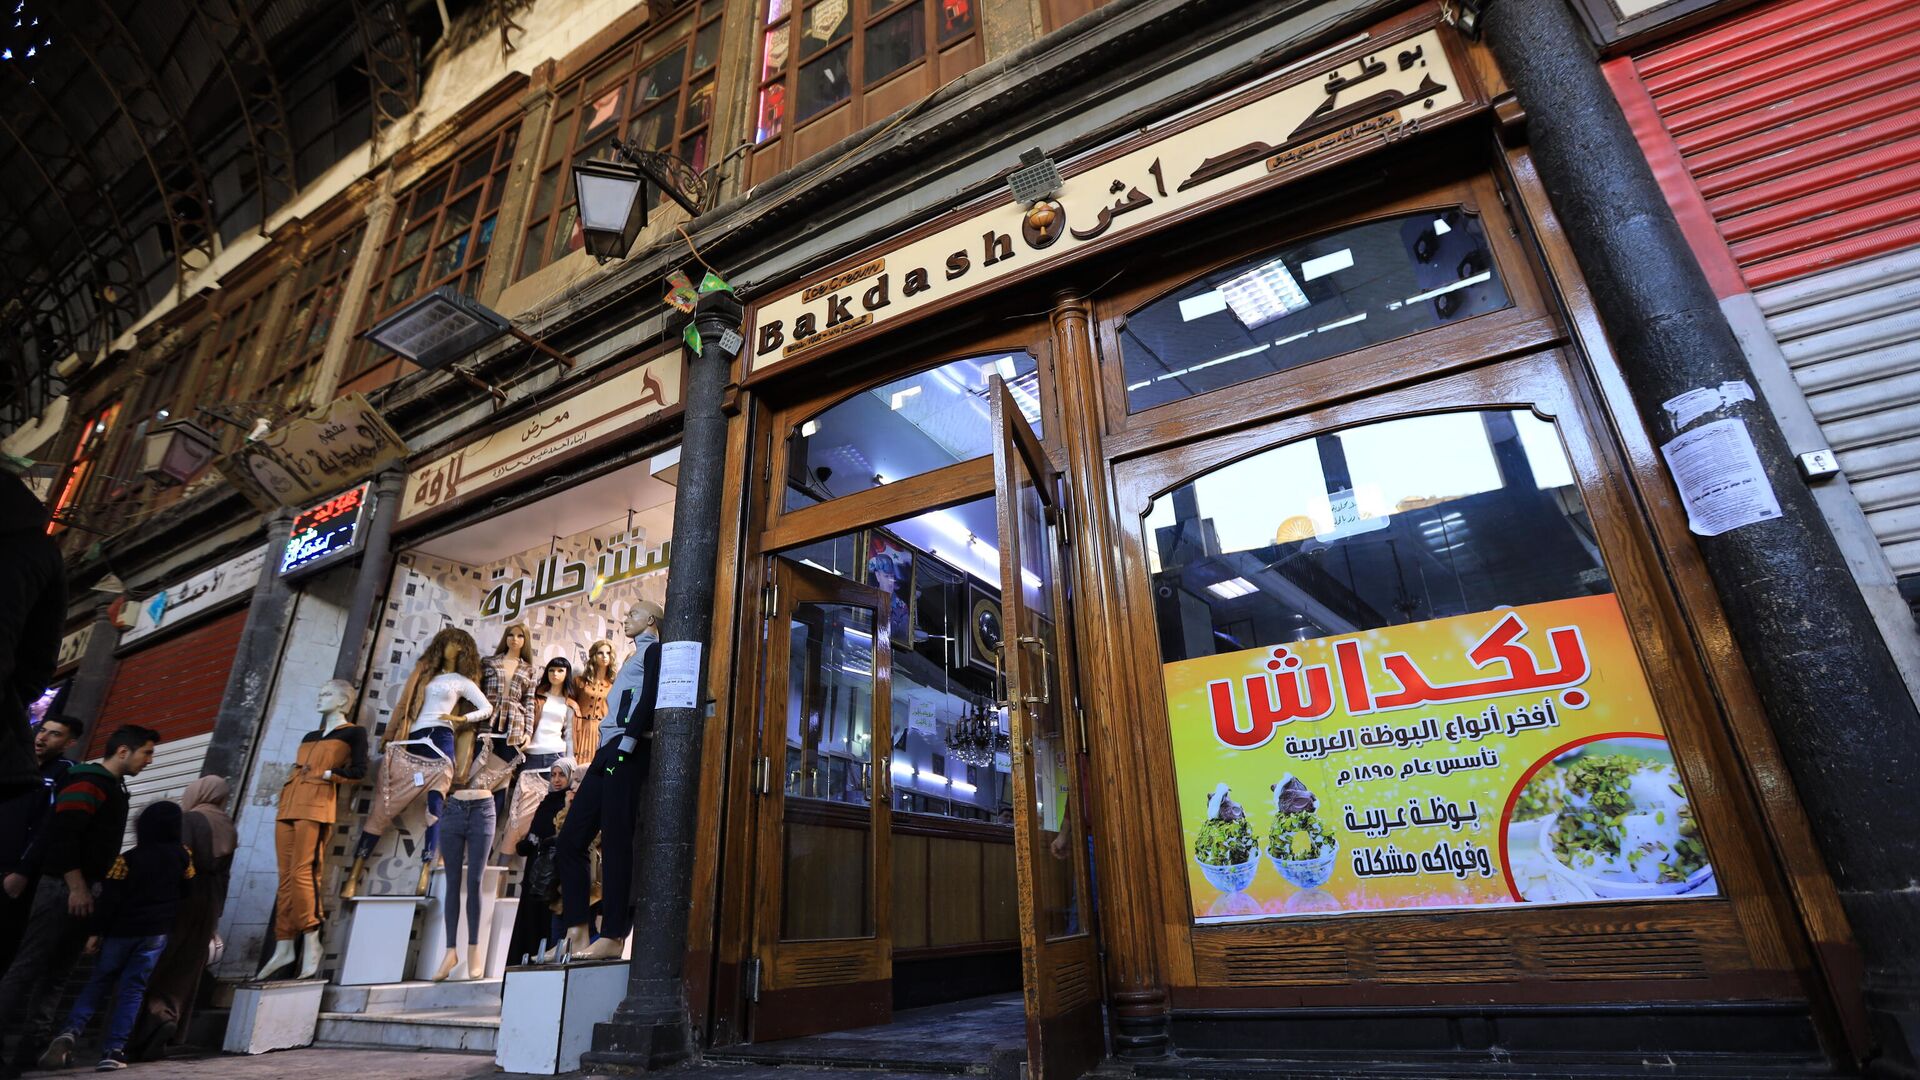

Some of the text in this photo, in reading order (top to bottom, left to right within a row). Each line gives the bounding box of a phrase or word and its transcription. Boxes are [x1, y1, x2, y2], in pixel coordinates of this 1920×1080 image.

[1324, 45, 1423, 94] بوظة
[1070, 71, 1447, 240] بكداش
[757, 230, 1016, 356] Bakdash
[804, 263, 880, 301] Ice Cream
[521, 411, 570, 442] معرض
[480, 553, 586, 623] حلاوة
[1209, 613, 1590, 748] بكداش
[1284, 699, 1557, 759] أفخر أنواع البوظة العربية
[1337, 748, 1498, 786] تأسس عام ١٨٩٥ م
[1344, 796, 1479, 836] بوظة عربية
[1353, 841, 1491, 878] وفواكه مشكلة
